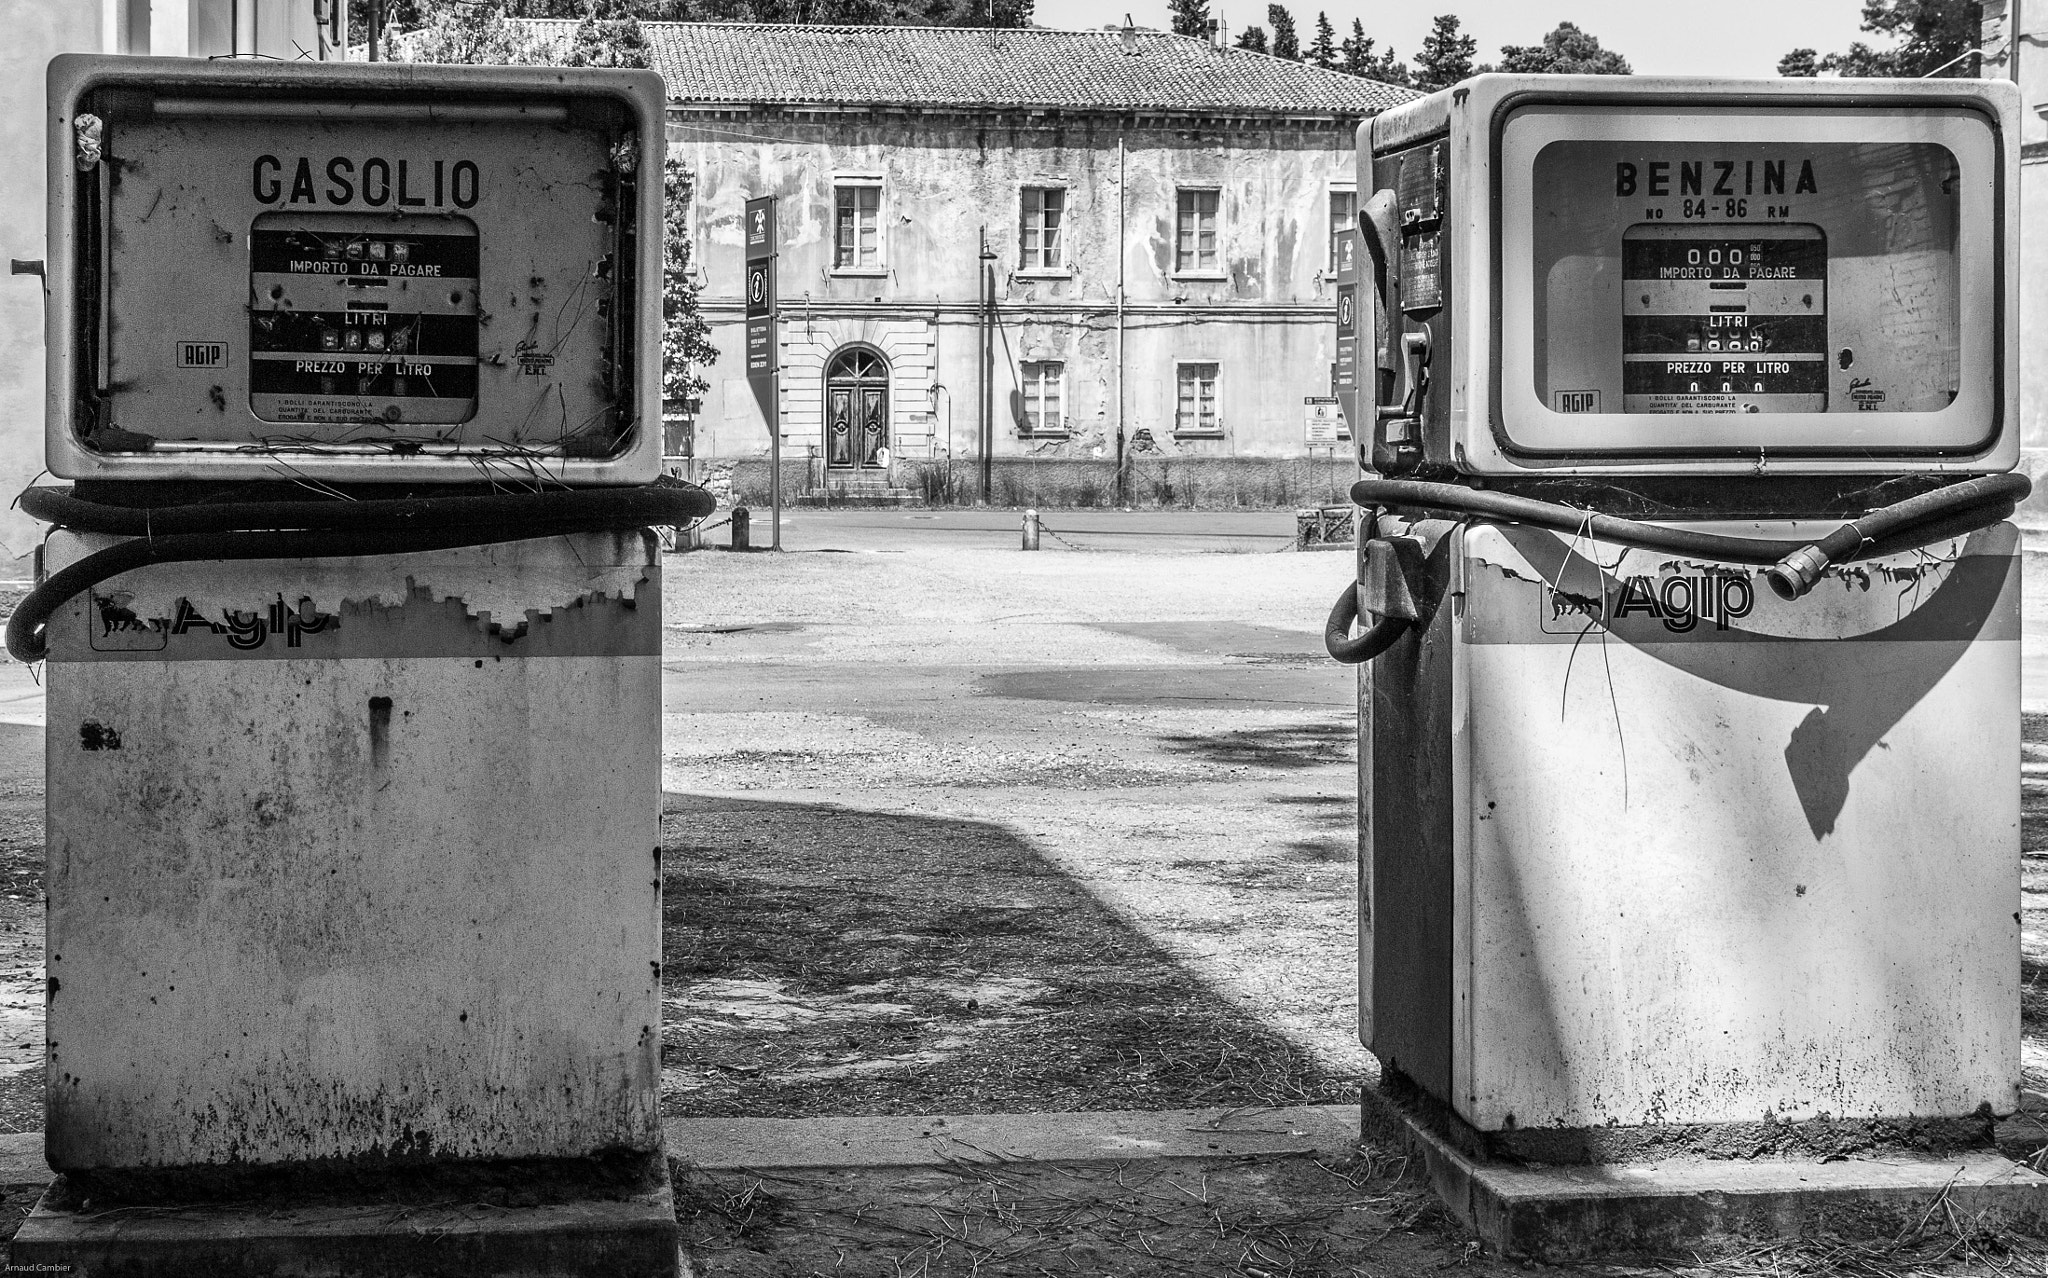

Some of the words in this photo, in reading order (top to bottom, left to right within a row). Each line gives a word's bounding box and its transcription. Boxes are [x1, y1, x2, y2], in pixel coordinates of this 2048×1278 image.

[252, 154, 480, 210] GASOLIO
[1616, 159, 1818, 197] BENZINA
[1645, 208, 1664, 219] NO
[1767, 205, 1790, 218] RM
[289, 260, 349, 274] IMPORTO
[361, 262, 380, 275] DA
[389, 263, 442, 277] PAGARE
[1659, 267, 1712, 279] IMPORTO
[1723, 267, 1740, 279] DA
[1749, 266, 1796, 279] PAGARE
[344, 312, 387, 326] LITRI
[1709, 316, 1749, 327] LITRI
[185, 345, 220, 365] AGIP
[295, 360, 346, 373] PREZZO
[358, 362, 383, 375] PER
[395, 362, 432, 376] LITRO
[1667, 362, 1712, 373] PREZZO
[1722, 362, 1745, 373] PER
[1756, 362, 1790, 373] LITRO
[1562, 393, 1594, 412] AGIP
[1613, 575, 1755, 634] Agip
